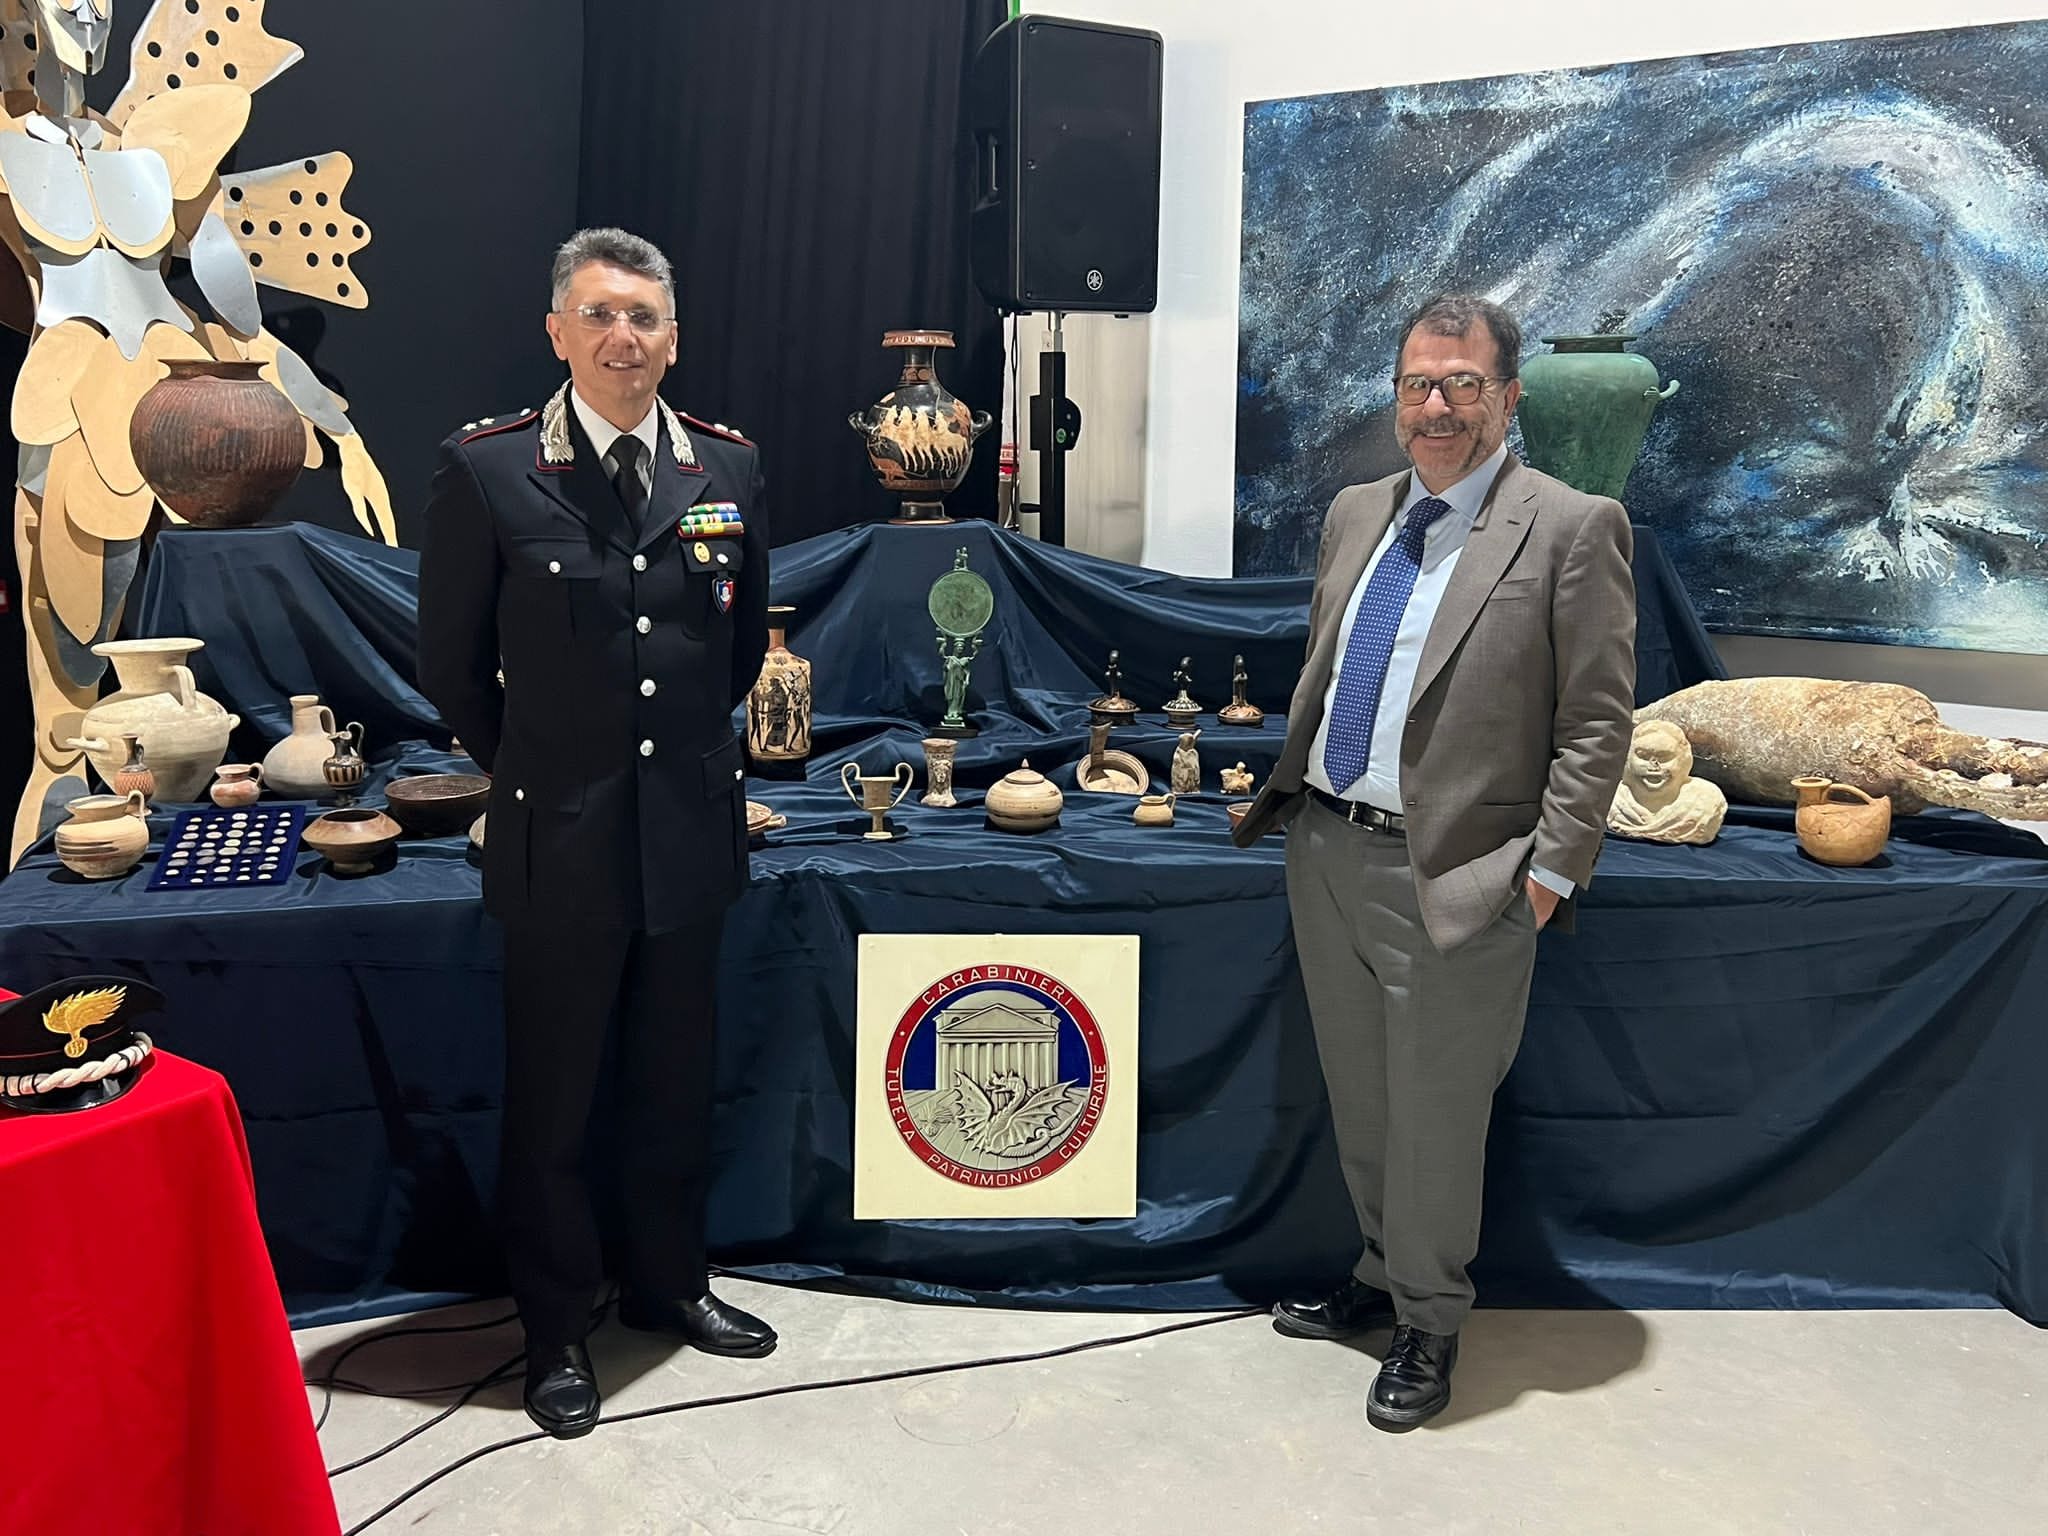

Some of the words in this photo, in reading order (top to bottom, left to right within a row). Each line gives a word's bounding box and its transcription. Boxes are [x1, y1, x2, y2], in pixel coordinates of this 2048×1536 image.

[922, 966, 1073, 1006] CARABINIERI
[887, 1068, 914, 1142] TUTELA
[927, 1153, 1042, 1187] PATRIMONIO
[1059, 1064, 1107, 1159] CULTURALE
